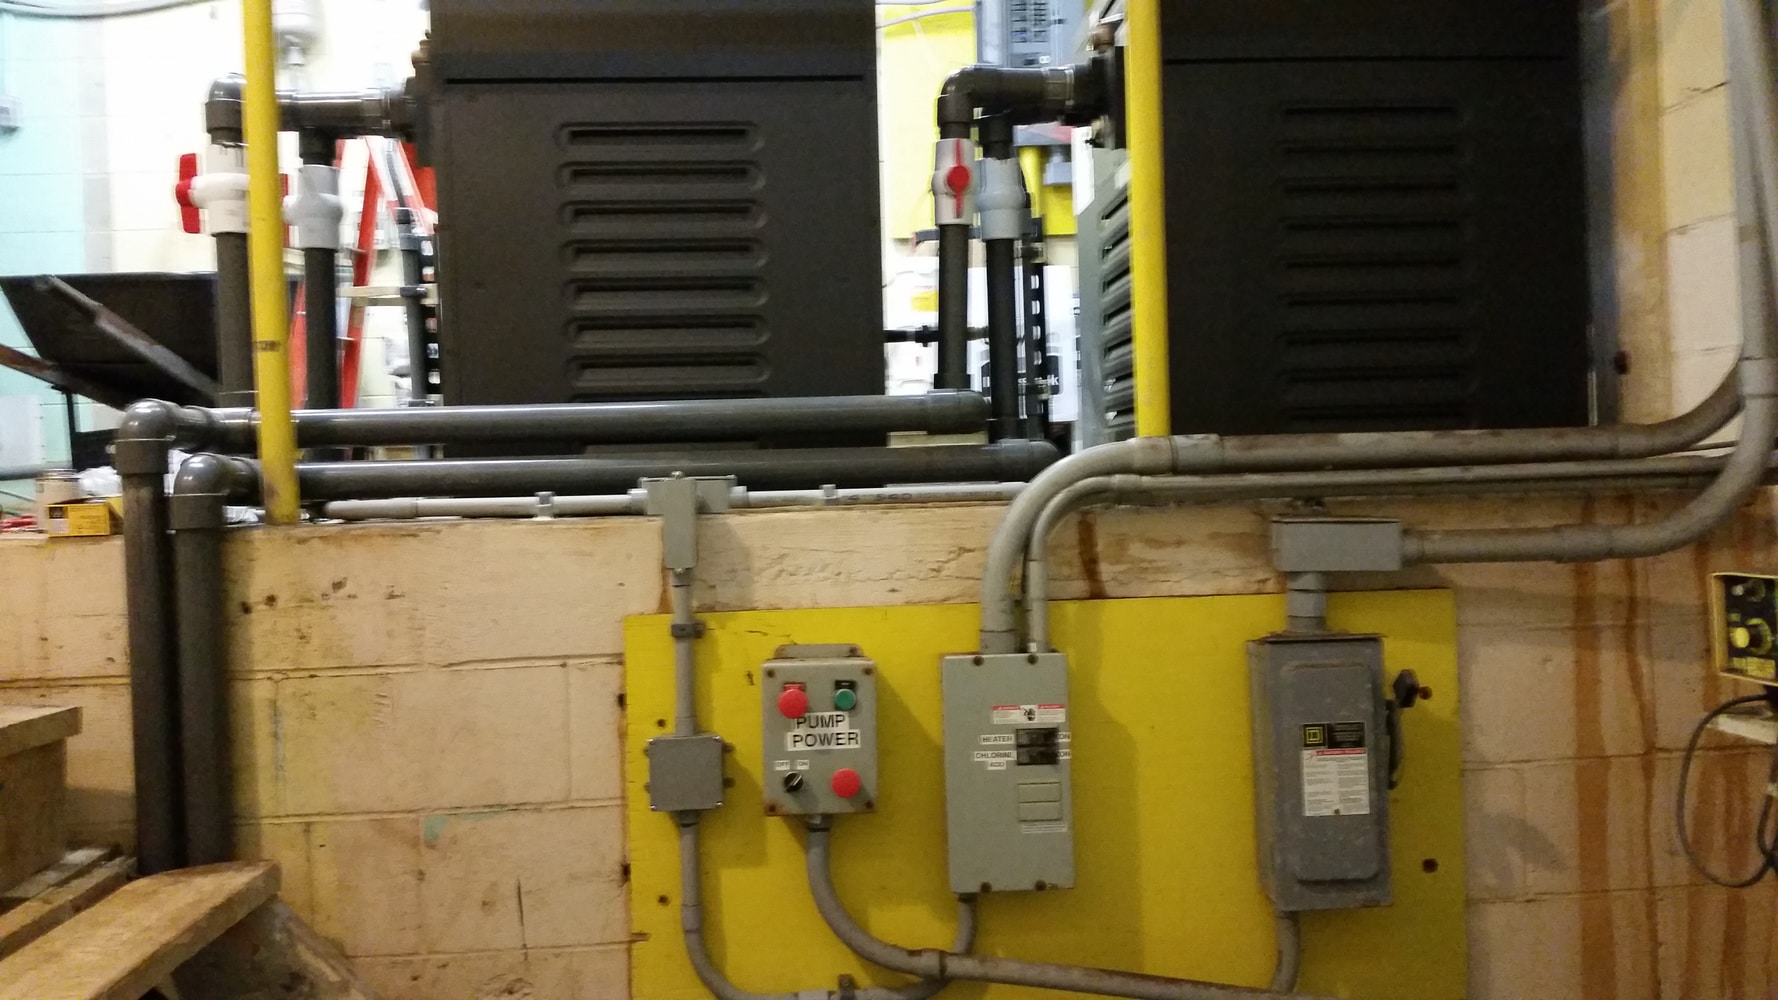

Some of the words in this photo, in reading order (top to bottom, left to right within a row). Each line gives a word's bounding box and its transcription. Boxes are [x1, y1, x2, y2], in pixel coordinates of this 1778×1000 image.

[796, 714, 846, 729] PUMP
[793, 732, 859, 747] POWER
[975, 751, 1013, 759] CHLORINE
